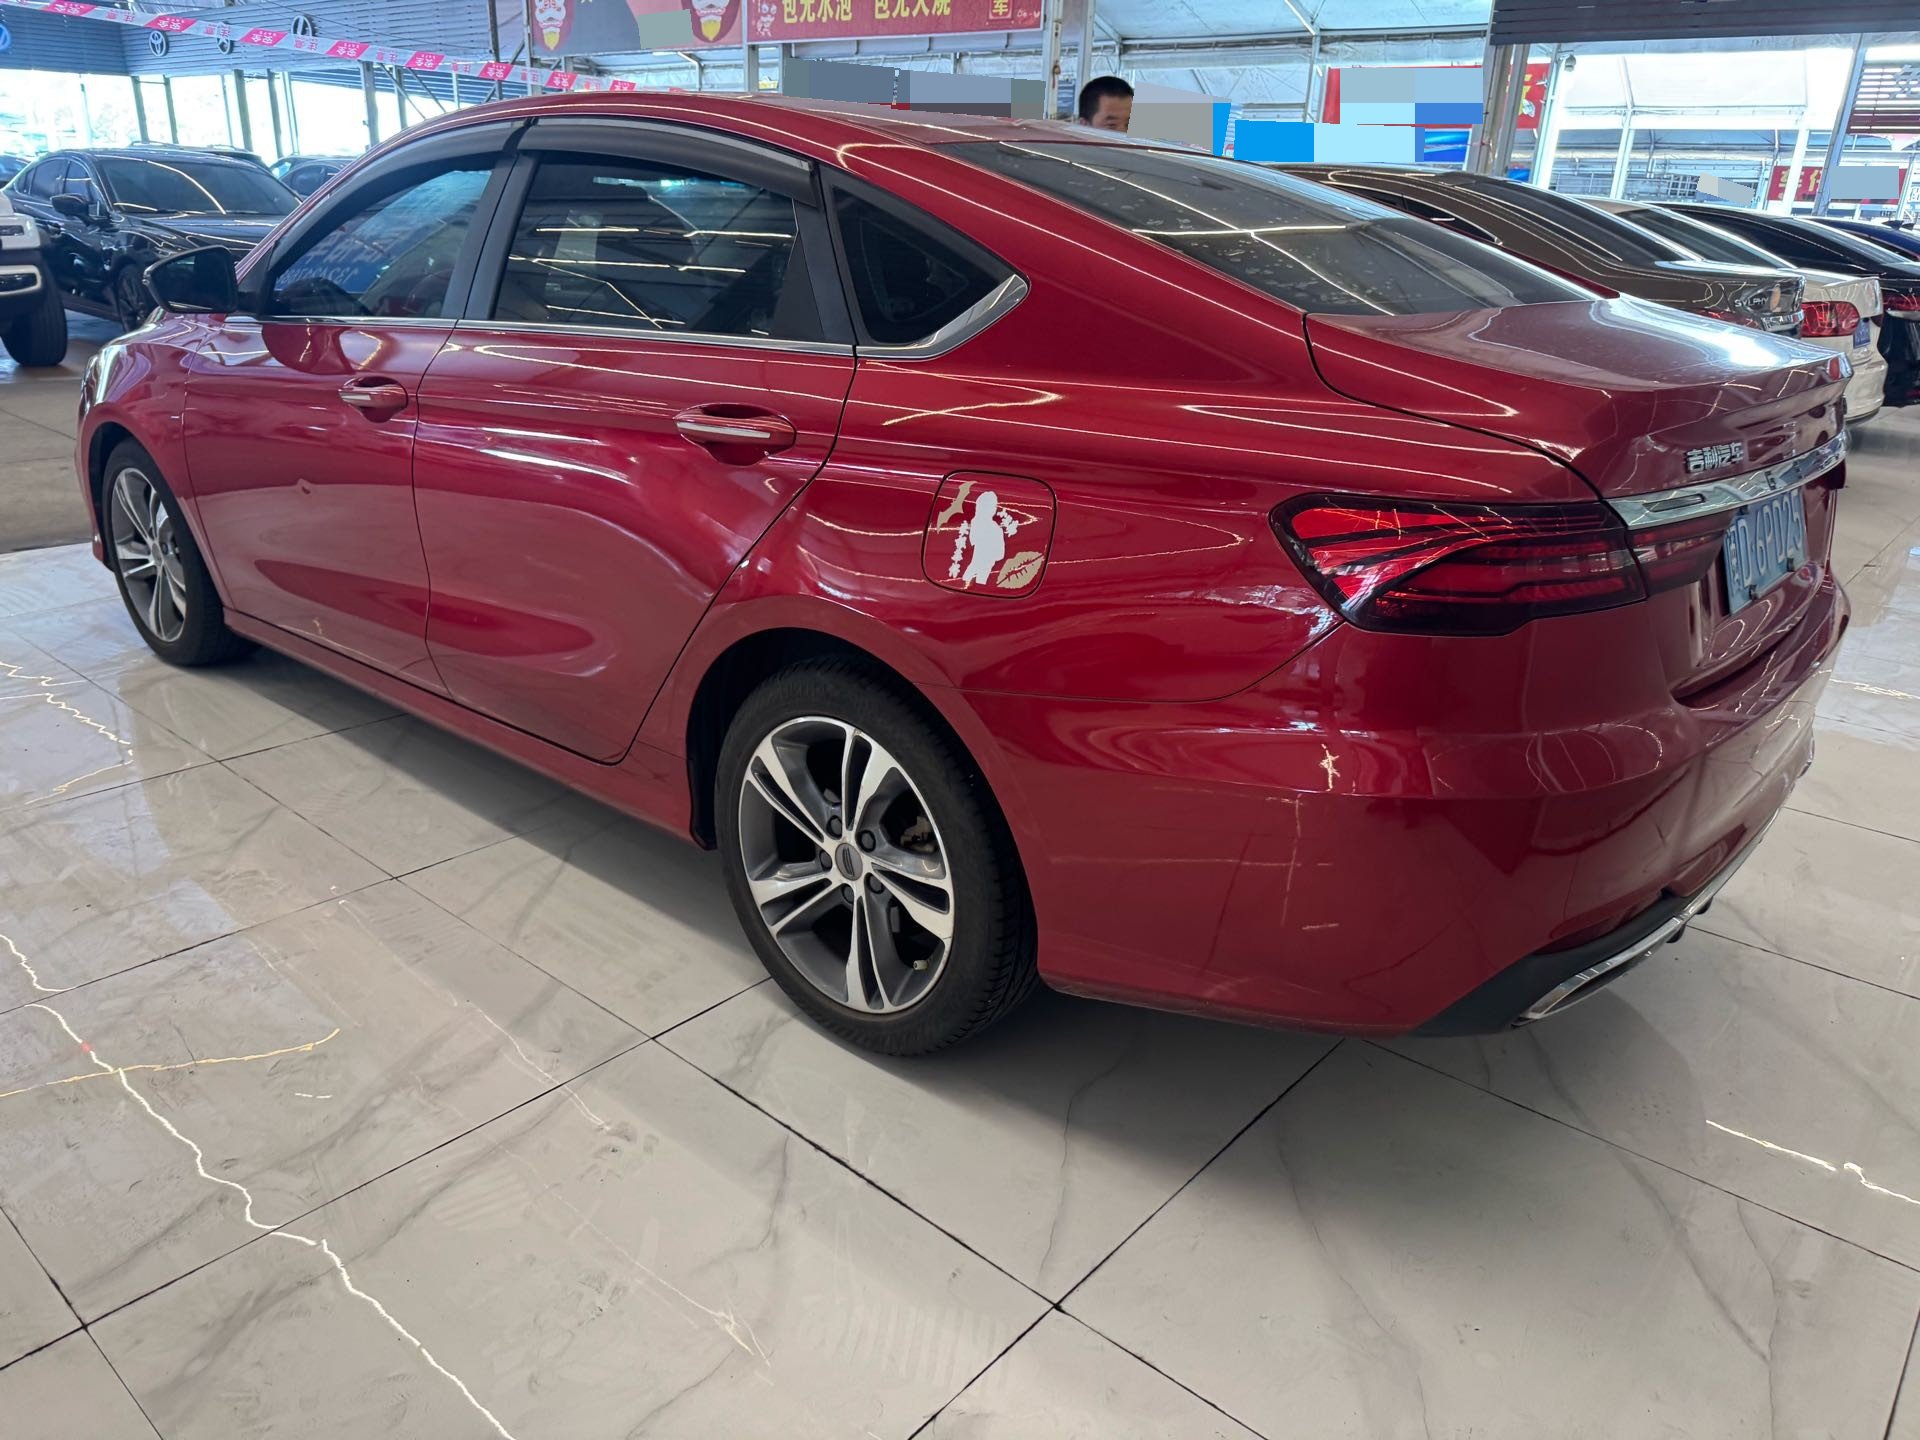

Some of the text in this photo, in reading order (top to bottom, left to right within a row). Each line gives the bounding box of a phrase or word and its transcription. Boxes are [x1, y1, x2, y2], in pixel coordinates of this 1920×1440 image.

[1734, 297, 1769, 308] SYLPHY
[1687, 442, 1744, 473] 吉利汽车
